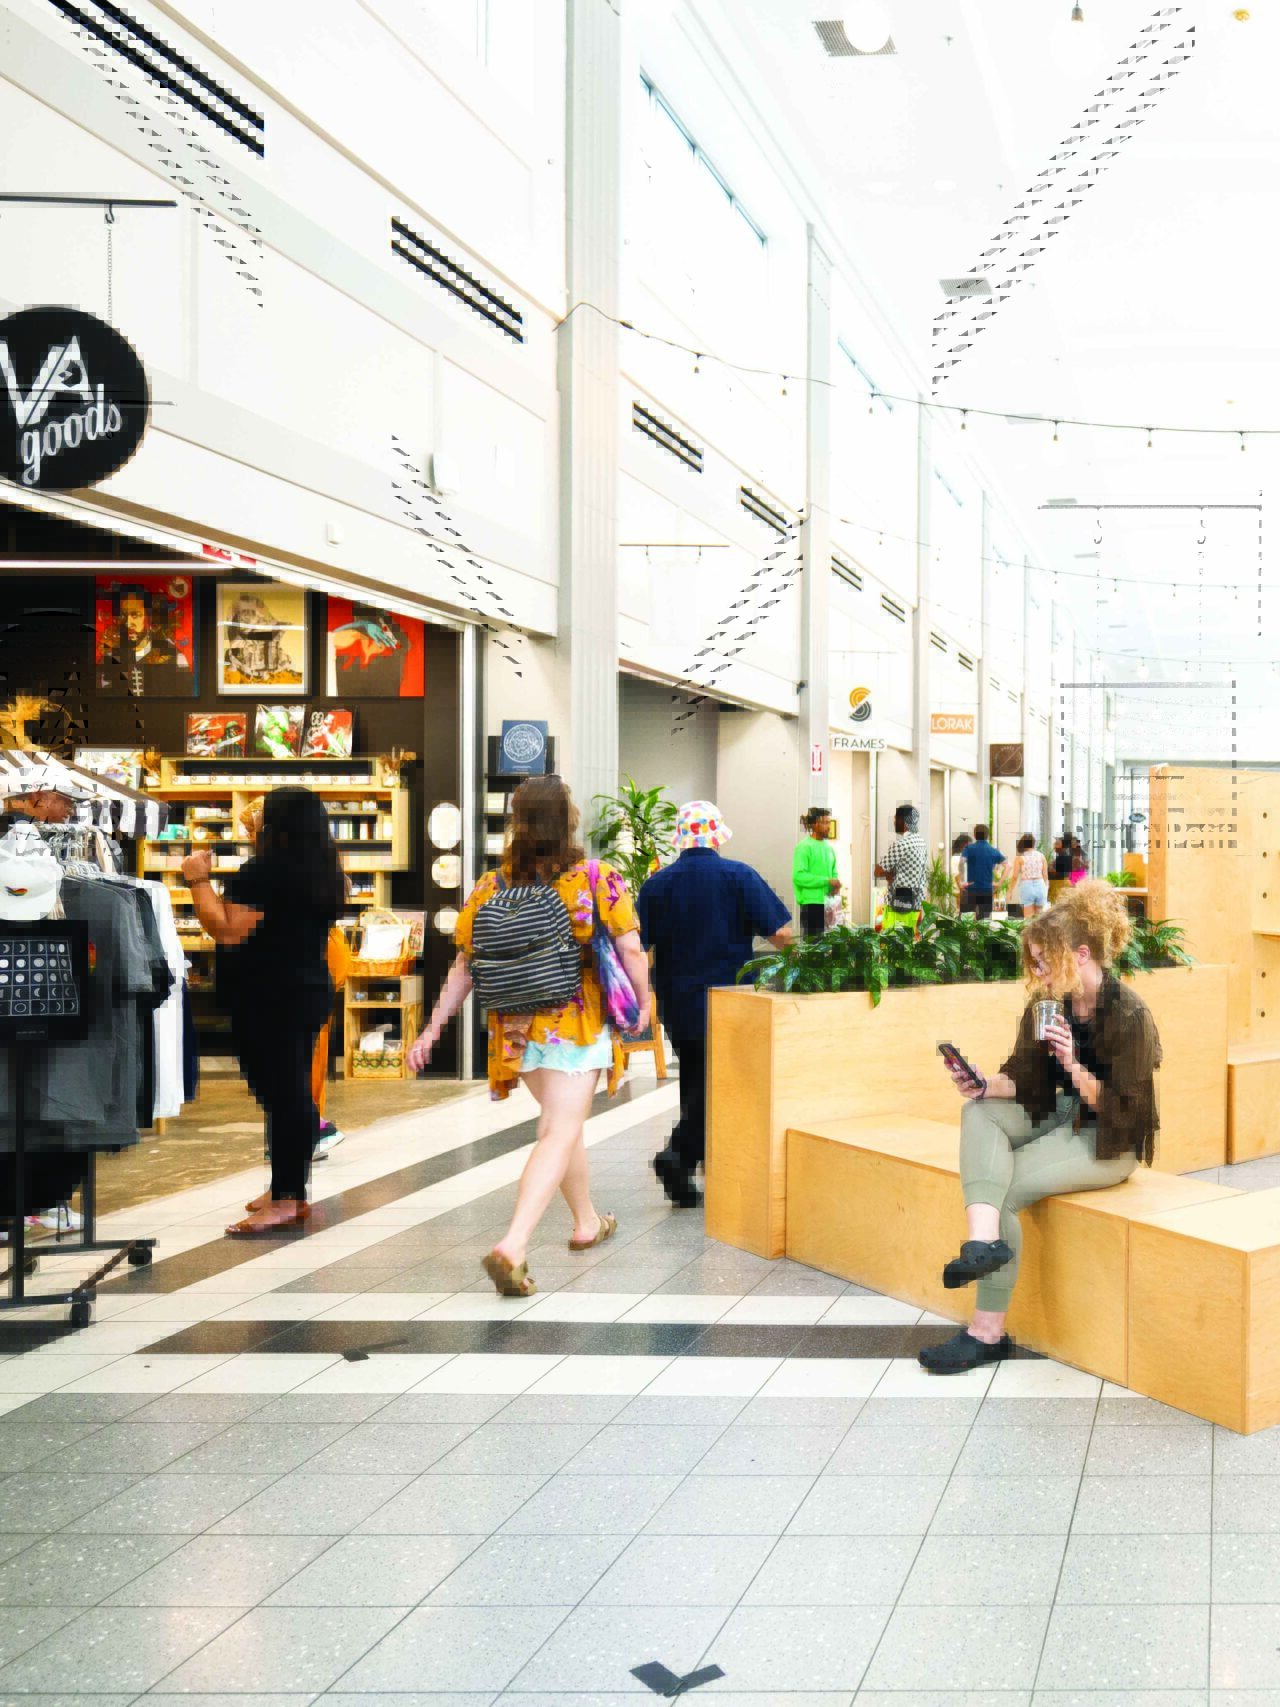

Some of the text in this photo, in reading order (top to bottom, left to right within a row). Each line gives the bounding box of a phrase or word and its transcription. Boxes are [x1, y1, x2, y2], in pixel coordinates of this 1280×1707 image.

[0, 334, 95, 429] VA
[21, 383, 123, 485] goods
[834, 737, 885, 749] FRAMES
[932, 717, 973, 731] LORAK
